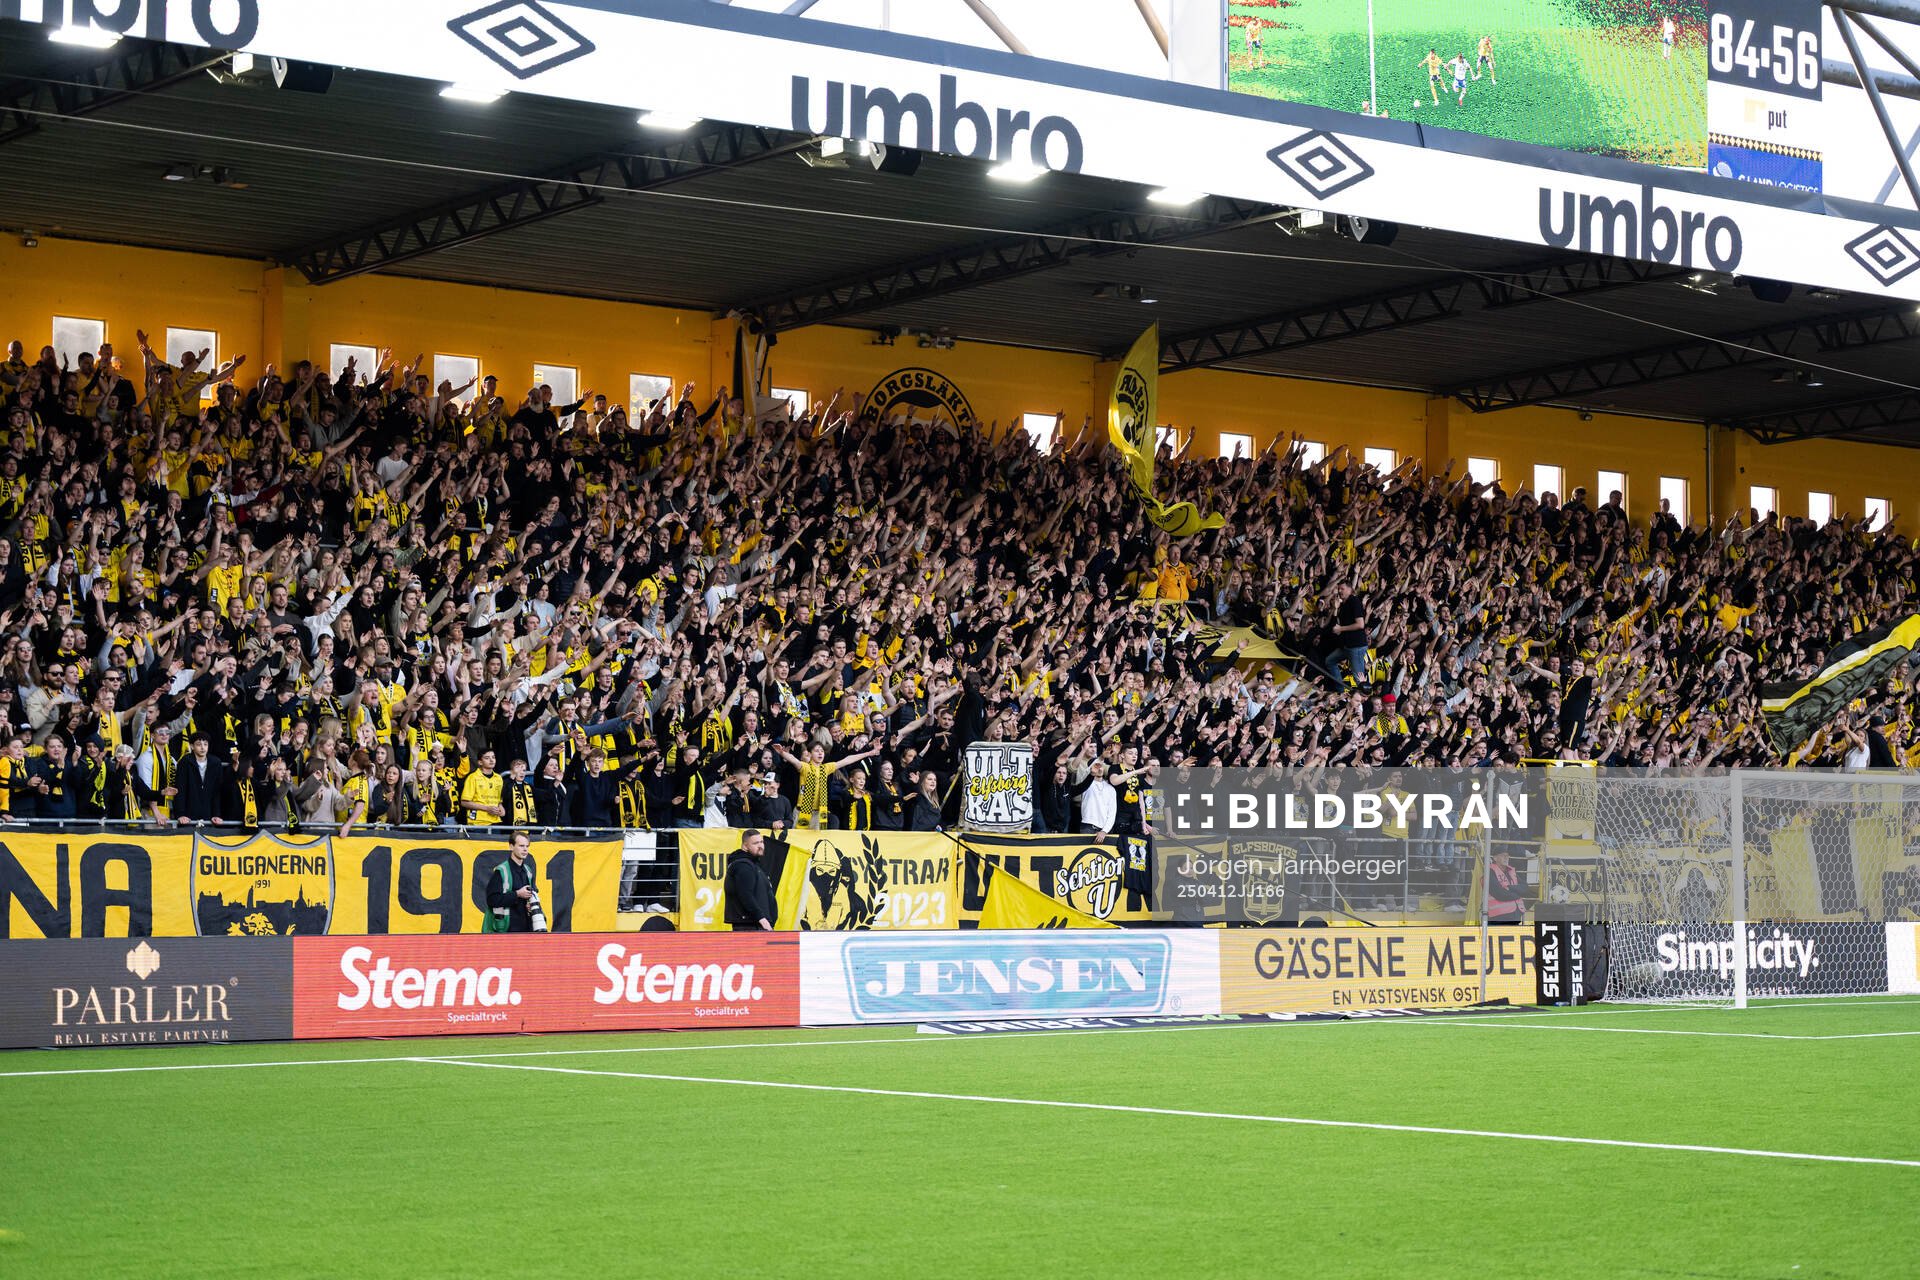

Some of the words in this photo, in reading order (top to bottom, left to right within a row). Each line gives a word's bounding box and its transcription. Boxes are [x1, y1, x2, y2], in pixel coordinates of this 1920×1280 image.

[791, 75, 1083, 174] umbro
[1539, 184, 1742, 272] umbro
[200, 855, 326, 876] GULIGANERNA
[1232, 841, 1298, 859] ELFSBORGS
[254, 879, 271, 889] 1991
[1254, 936, 1406, 980] GÄSENE
[1541, 923, 1560, 998] SELECT
[1570, 923, 1584, 997] SELECT
[1657, 930, 1819, 979] Simpicity.
[865, 957, 1151, 998] JENSEN
[1333, 990, 1351, 1005] EN
[1359, 987, 1446, 1004] VÄSTSVENSK
[52, 985, 232, 1026] PARLER
[447, 1011, 508, 1023] Specialtryck
[694, 1006, 750, 1017] Specialtryck
[55, 1034, 94, 1045] REAL
[102, 1032, 156, 1044] ESTATE
[164, 1030, 229, 1041] PARTNER
